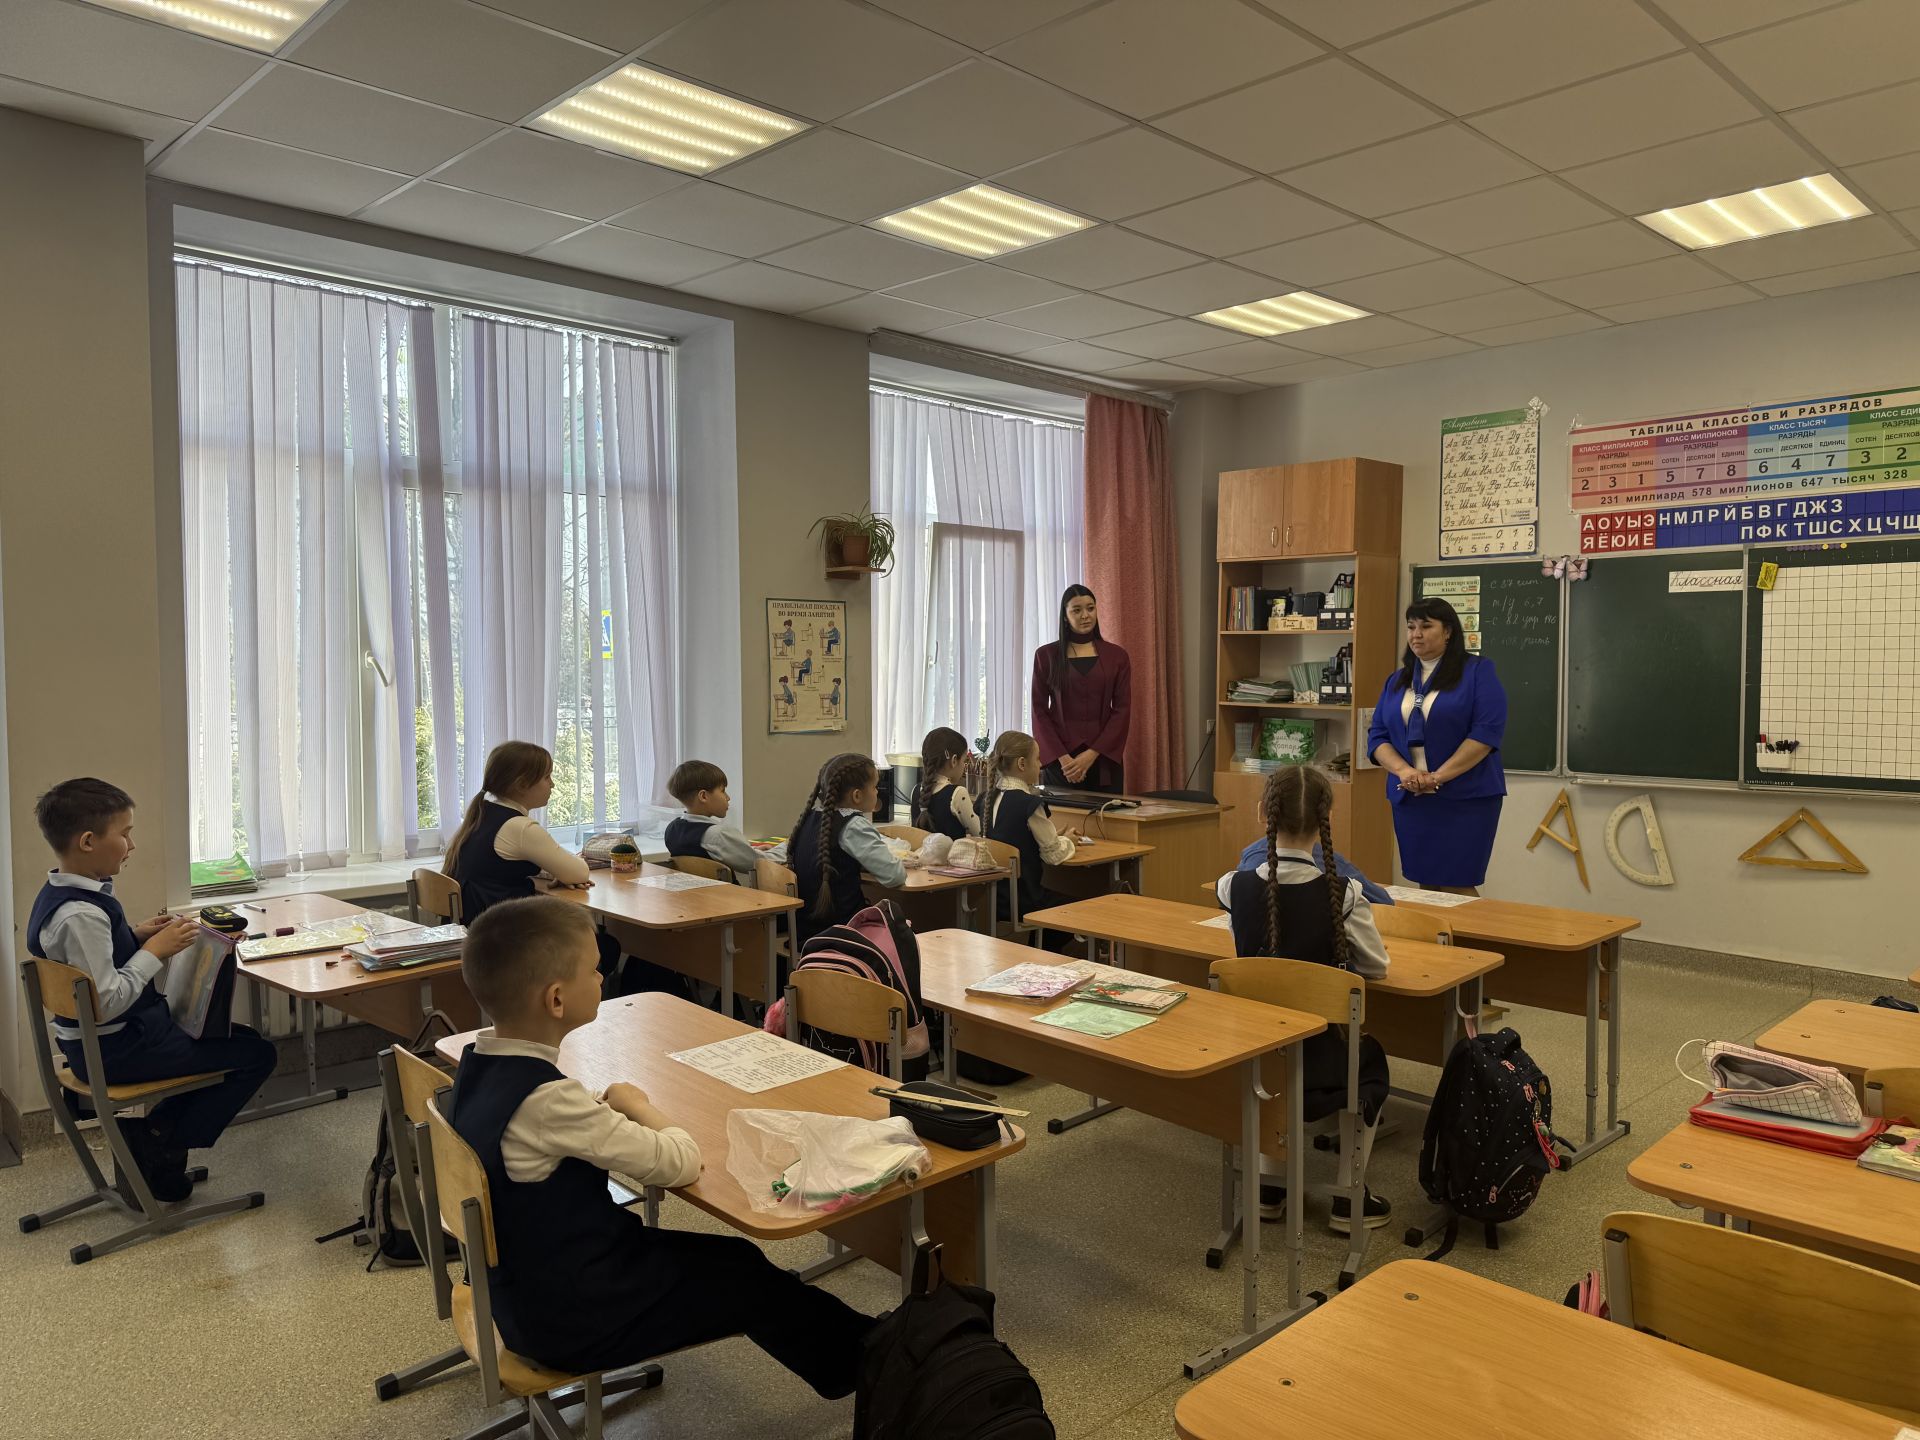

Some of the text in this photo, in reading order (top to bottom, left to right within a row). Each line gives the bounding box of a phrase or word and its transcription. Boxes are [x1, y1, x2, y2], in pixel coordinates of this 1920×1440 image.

[1630, 398, 1882, 436] ТАБЛИЦА КЛАССОВ И РАЗРЯДОВ
[1870, 407, 1920, 420] КЛАСС ЕДИ
[1769, 418, 1826, 431] КЛАСС ТЫСЯЧ
[1665, 429, 1738, 443] КЛАСС МИЛЛИОНОВ
[1778, 430, 1816, 440] РАЗРЯДЫ
[1579, 440, 1649, 452] КЛАСС МИЛЛИАРДОВ
[1600, 462, 1626, 471] ДЕСЯТКОВ
[1632, 460, 1654, 468] ЕДИНИЦ
[1686, 453, 1716, 462] ДЕСЯТКОВ
[1721, 450, 1745, 458] ЕДИНИЦ
[1780, 442, 1813, 452] ДЕСЯТКОВ
[1820, 440, 1846, 448] ЕДИНИЦ
[1884, 430, 1920, 441] ДЕСЯТКОВ
[1684, 442, 1719, 450] РАЗРЯДЫ
[1598, 451, 1630, 460] РАЗРЯДЫ
[1581, 446, 1907, 491] 2 3 1 5 7 8 6 4 7 3 2
[1600, 468, 1908, 505] 231 миллиард 578 миллионов 647 тысяч 328
[1528, 528, 1534, 536] 2
[1444, 540, 1533, 555] 3 4 5 6 7 8 9
[1670, 572, 1743, 588] Классная
